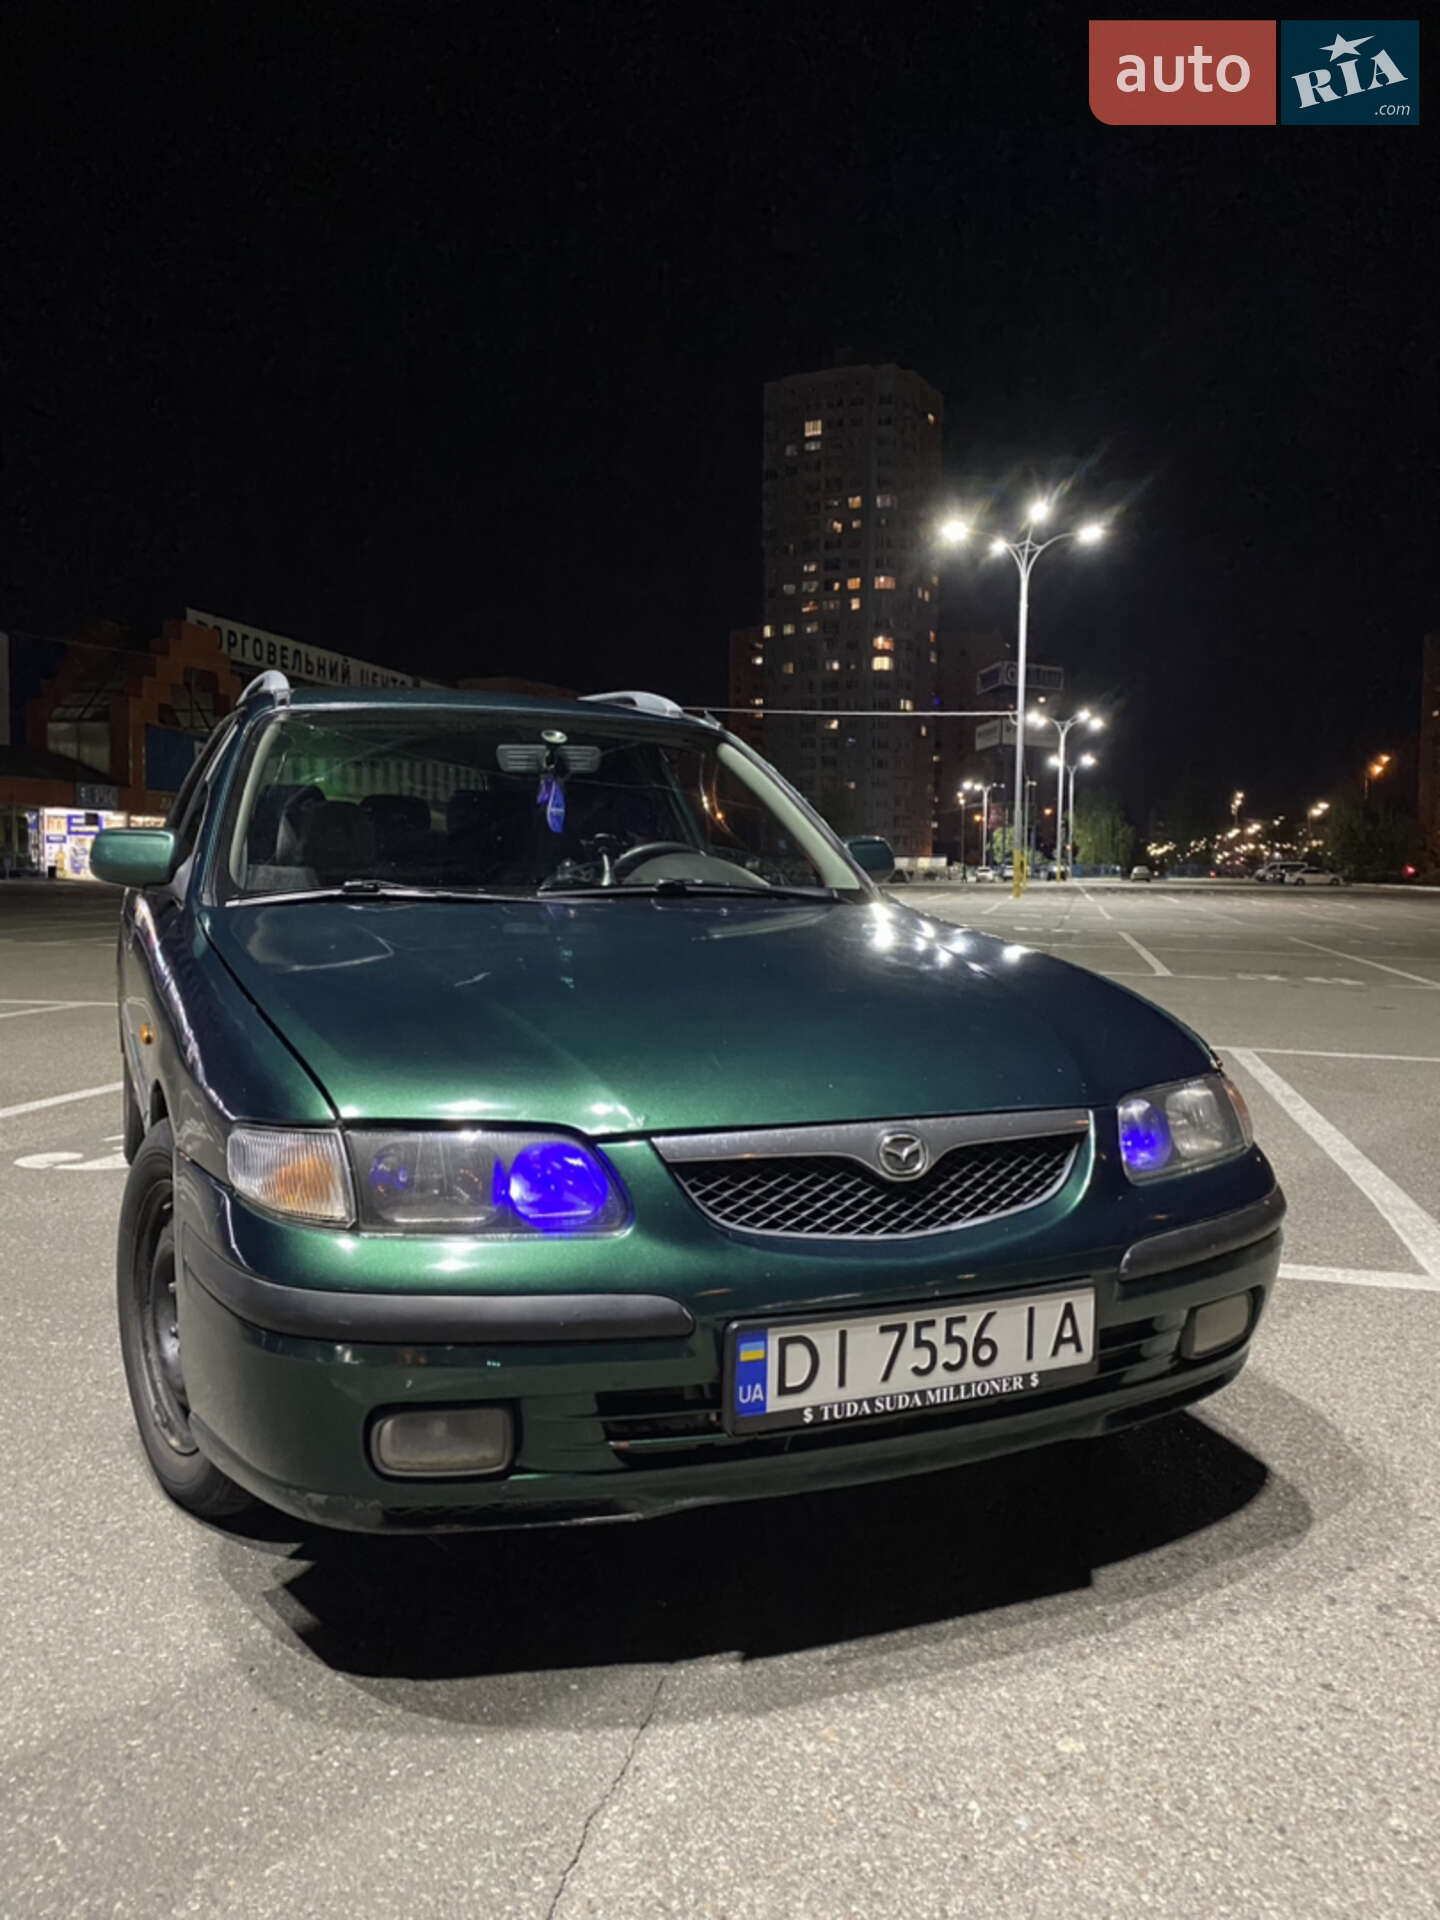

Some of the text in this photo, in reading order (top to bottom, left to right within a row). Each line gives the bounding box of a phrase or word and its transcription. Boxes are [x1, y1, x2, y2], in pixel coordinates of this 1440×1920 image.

[777, 1301, 1084, 1396] DI 7556 IA
[738, 1386, 764, 1404] UA
[820, 1399, 872, 1421] TUDA
[873, 1391, 923, 1413] SUDA
[925, 1376, 1024, 1405] MILLIONER
